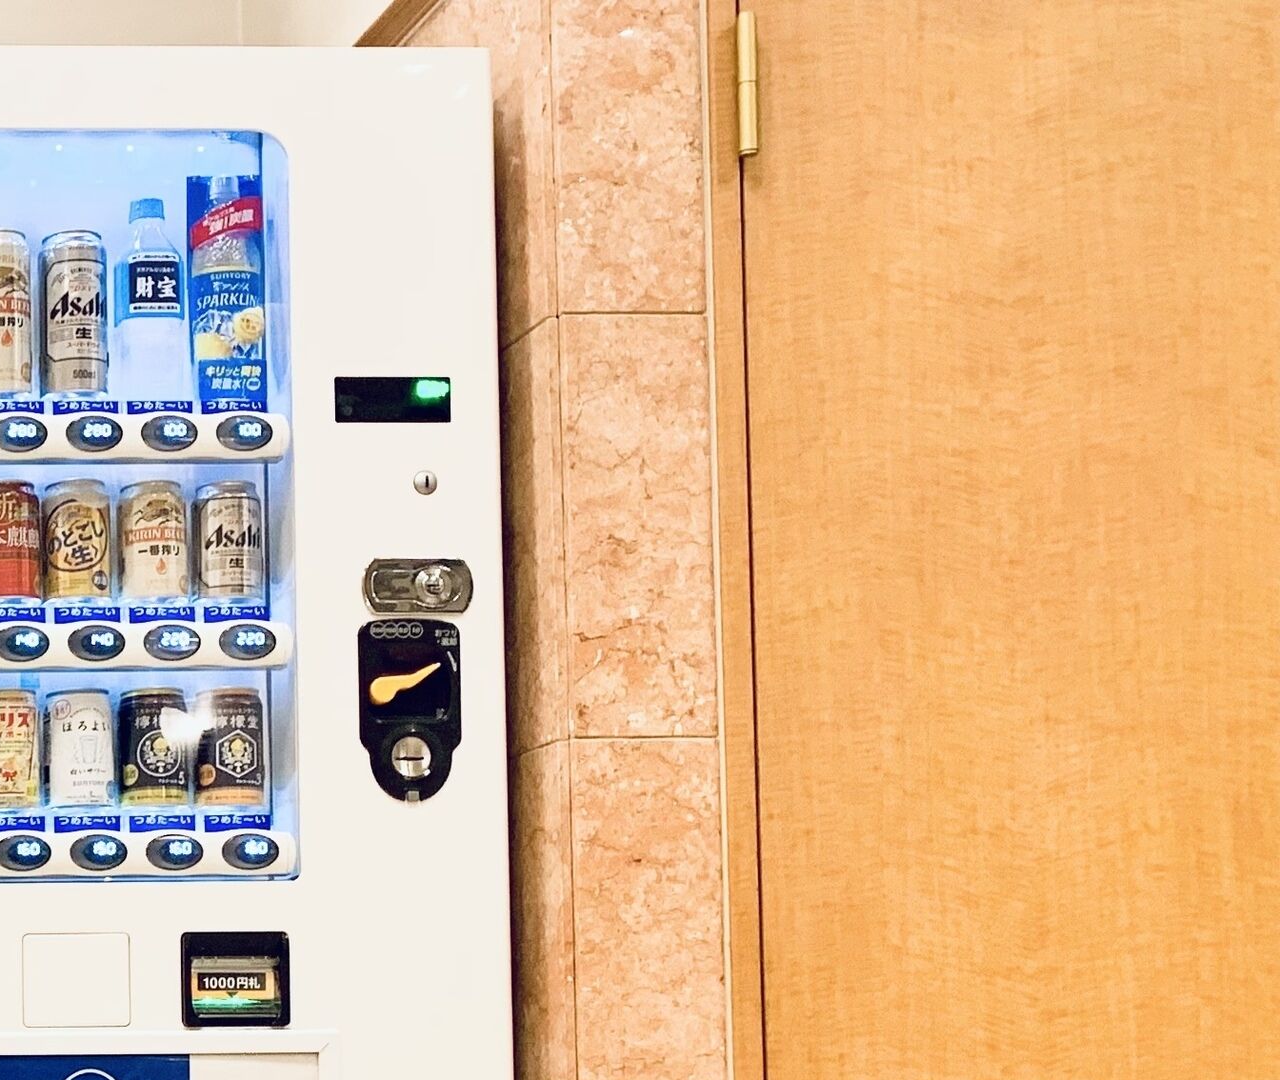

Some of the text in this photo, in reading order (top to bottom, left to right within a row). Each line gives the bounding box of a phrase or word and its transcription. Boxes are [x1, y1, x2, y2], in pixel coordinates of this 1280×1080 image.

[135, 276, 177, 298] 財宝
[75, 326, 93, 339] 生
[47, 519, 104, 556] のどごし
[128, 527, 163, 542] KIRIN
[204, 523, 261, 550] Asahi
[138, 544, 180, 556] 一番搾り
[229, 558, 245, 569] 生
[61, 719, 110, 733] ほろよい
[203, 977, 260, 990] 1000円札
